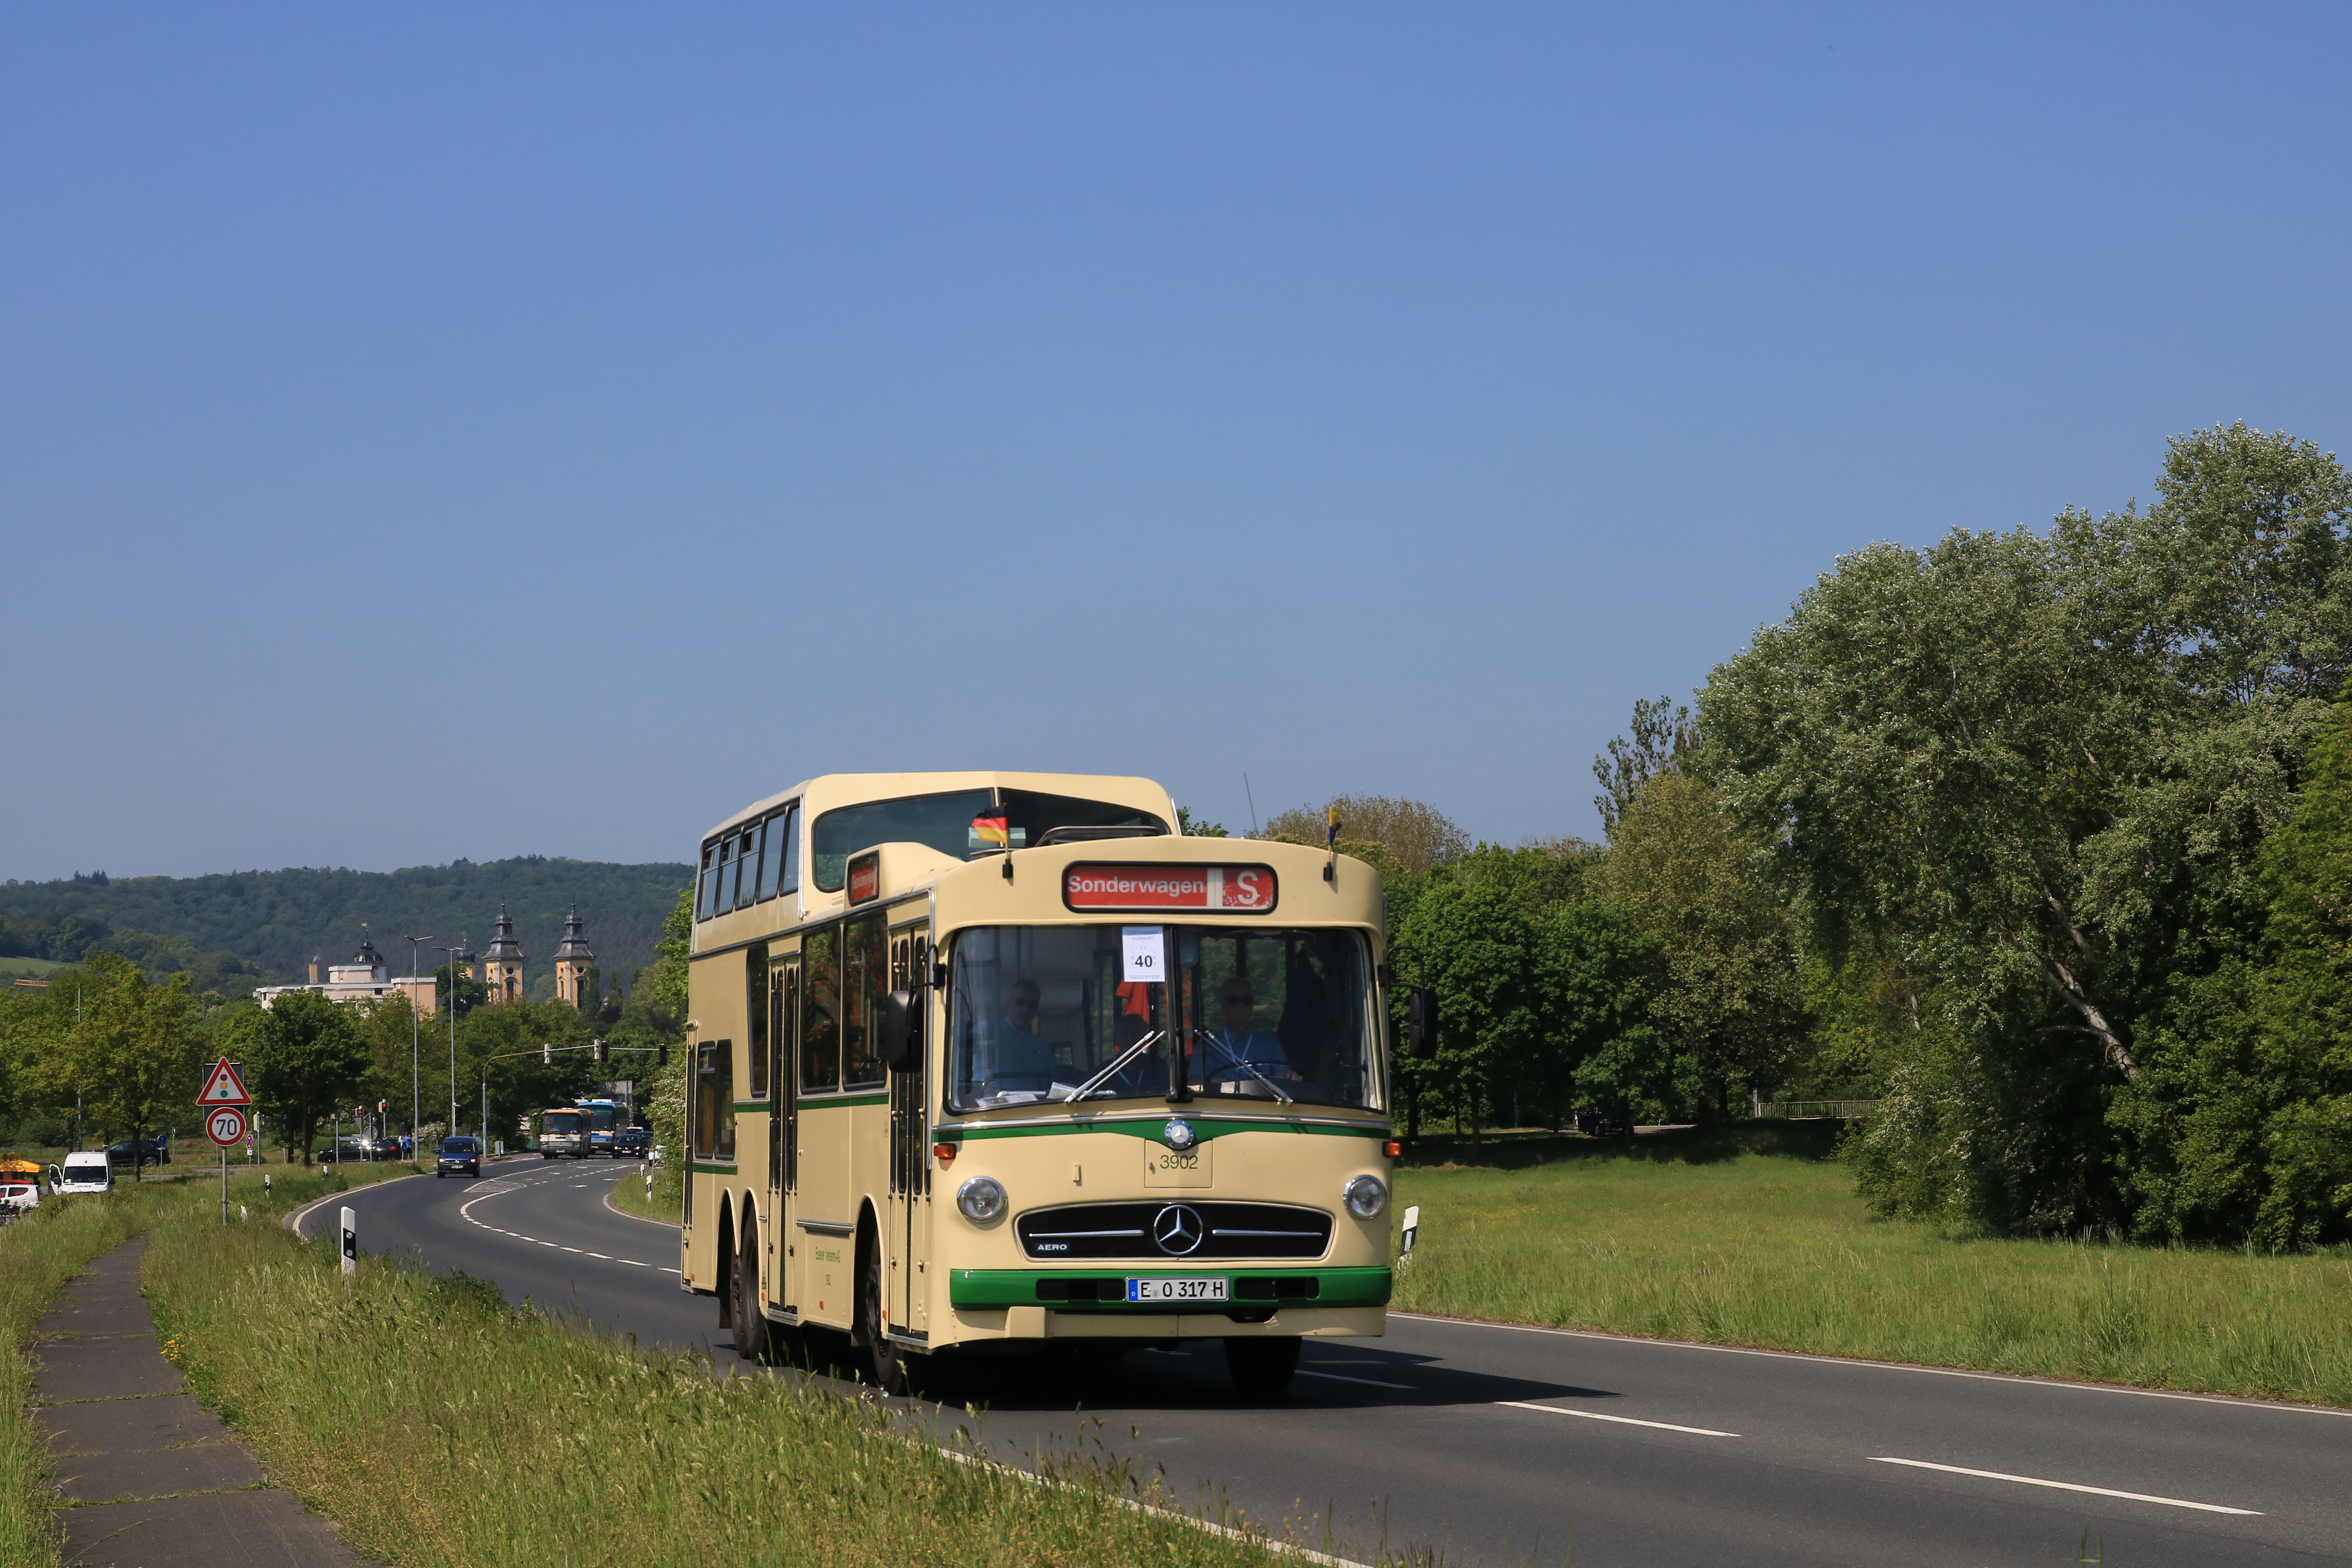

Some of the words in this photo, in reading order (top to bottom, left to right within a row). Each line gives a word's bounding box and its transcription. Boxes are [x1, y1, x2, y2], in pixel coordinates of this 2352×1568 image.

[1068, 875, 1204, 897] Sonderwagen
[1237, 871, 1259, 904] S
[1135, 955, 1152, 967] 40
[216, 1119, 237, 1136] 70
[1160, 1155, 1198, 1169] 3902
[1141, 1282, 1151, 1298] E
[1178, 1281, 1207, 1297] 317
[1213, 1281, 1223, 1296] H
